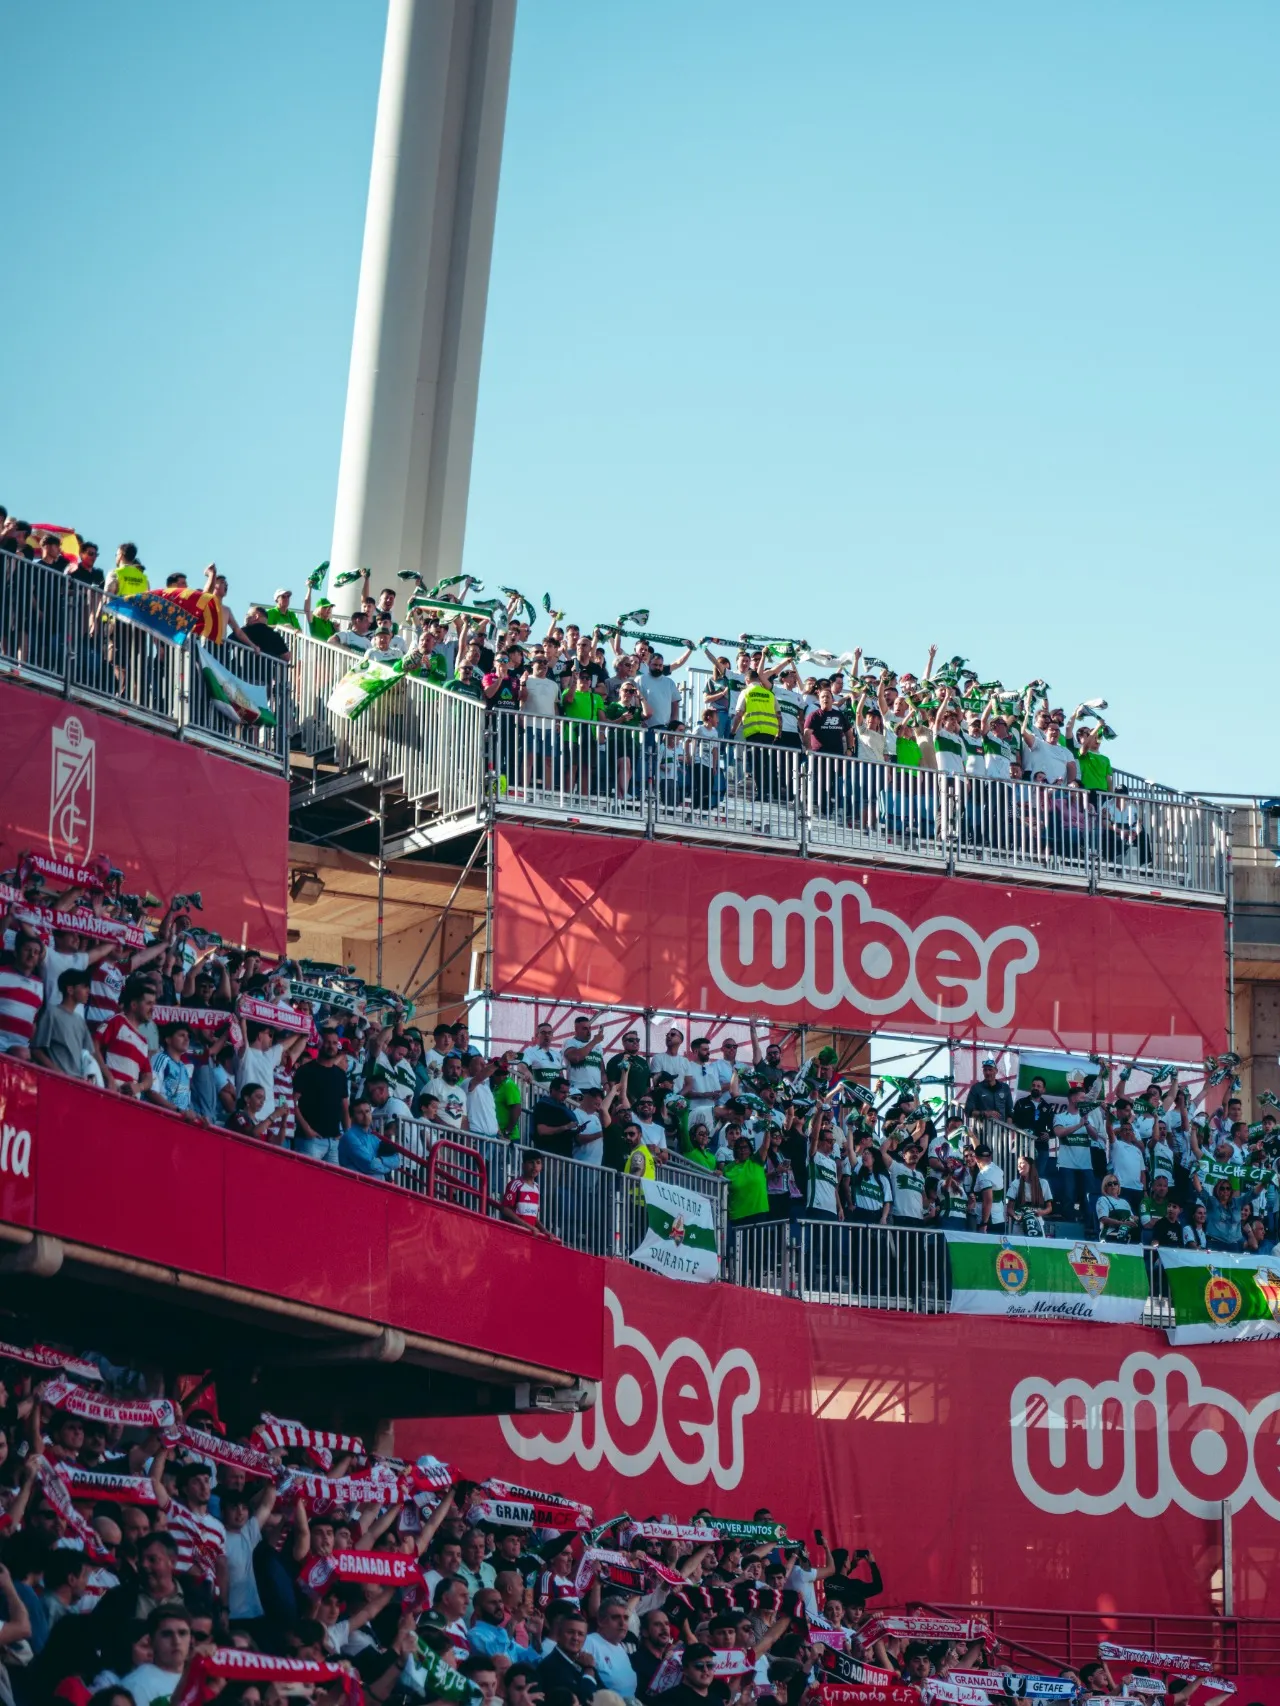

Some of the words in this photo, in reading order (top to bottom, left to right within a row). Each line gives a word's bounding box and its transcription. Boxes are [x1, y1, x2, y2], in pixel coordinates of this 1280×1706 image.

[708, 878, 1039, 1028] wiber
[290, 985, 331, 1002] ELCHE
[151, 1007, 200, 1025] ANADA
[1213, 1163, 1246, 1177] ELCHE
[1250, 1167, 1267, 1179] CF
[1006, 1304, 1026, 1315] Peña
[1027, 1300, 1094, 1317] Marbella
[103, 1405, 116, 1419] DEL
[118, 1408, 153, 1423] GRANADA
[496, 1503, 553, 1524] GRANADA
[676, 1523, 708, 1538] Lucha
[742, 1523, 772, 1536] JUNTOS
[339, 1554, 391, 1577] GRANADA
[393, 1560, 407, 1578] CF
[714, 1653, 738, 1672] ucha
[954, 1675, 999, 1688] GRANADA
[1032, 1682, 1064, 1693] GETAFE
[823, 1685, 887, 1702] Granada
